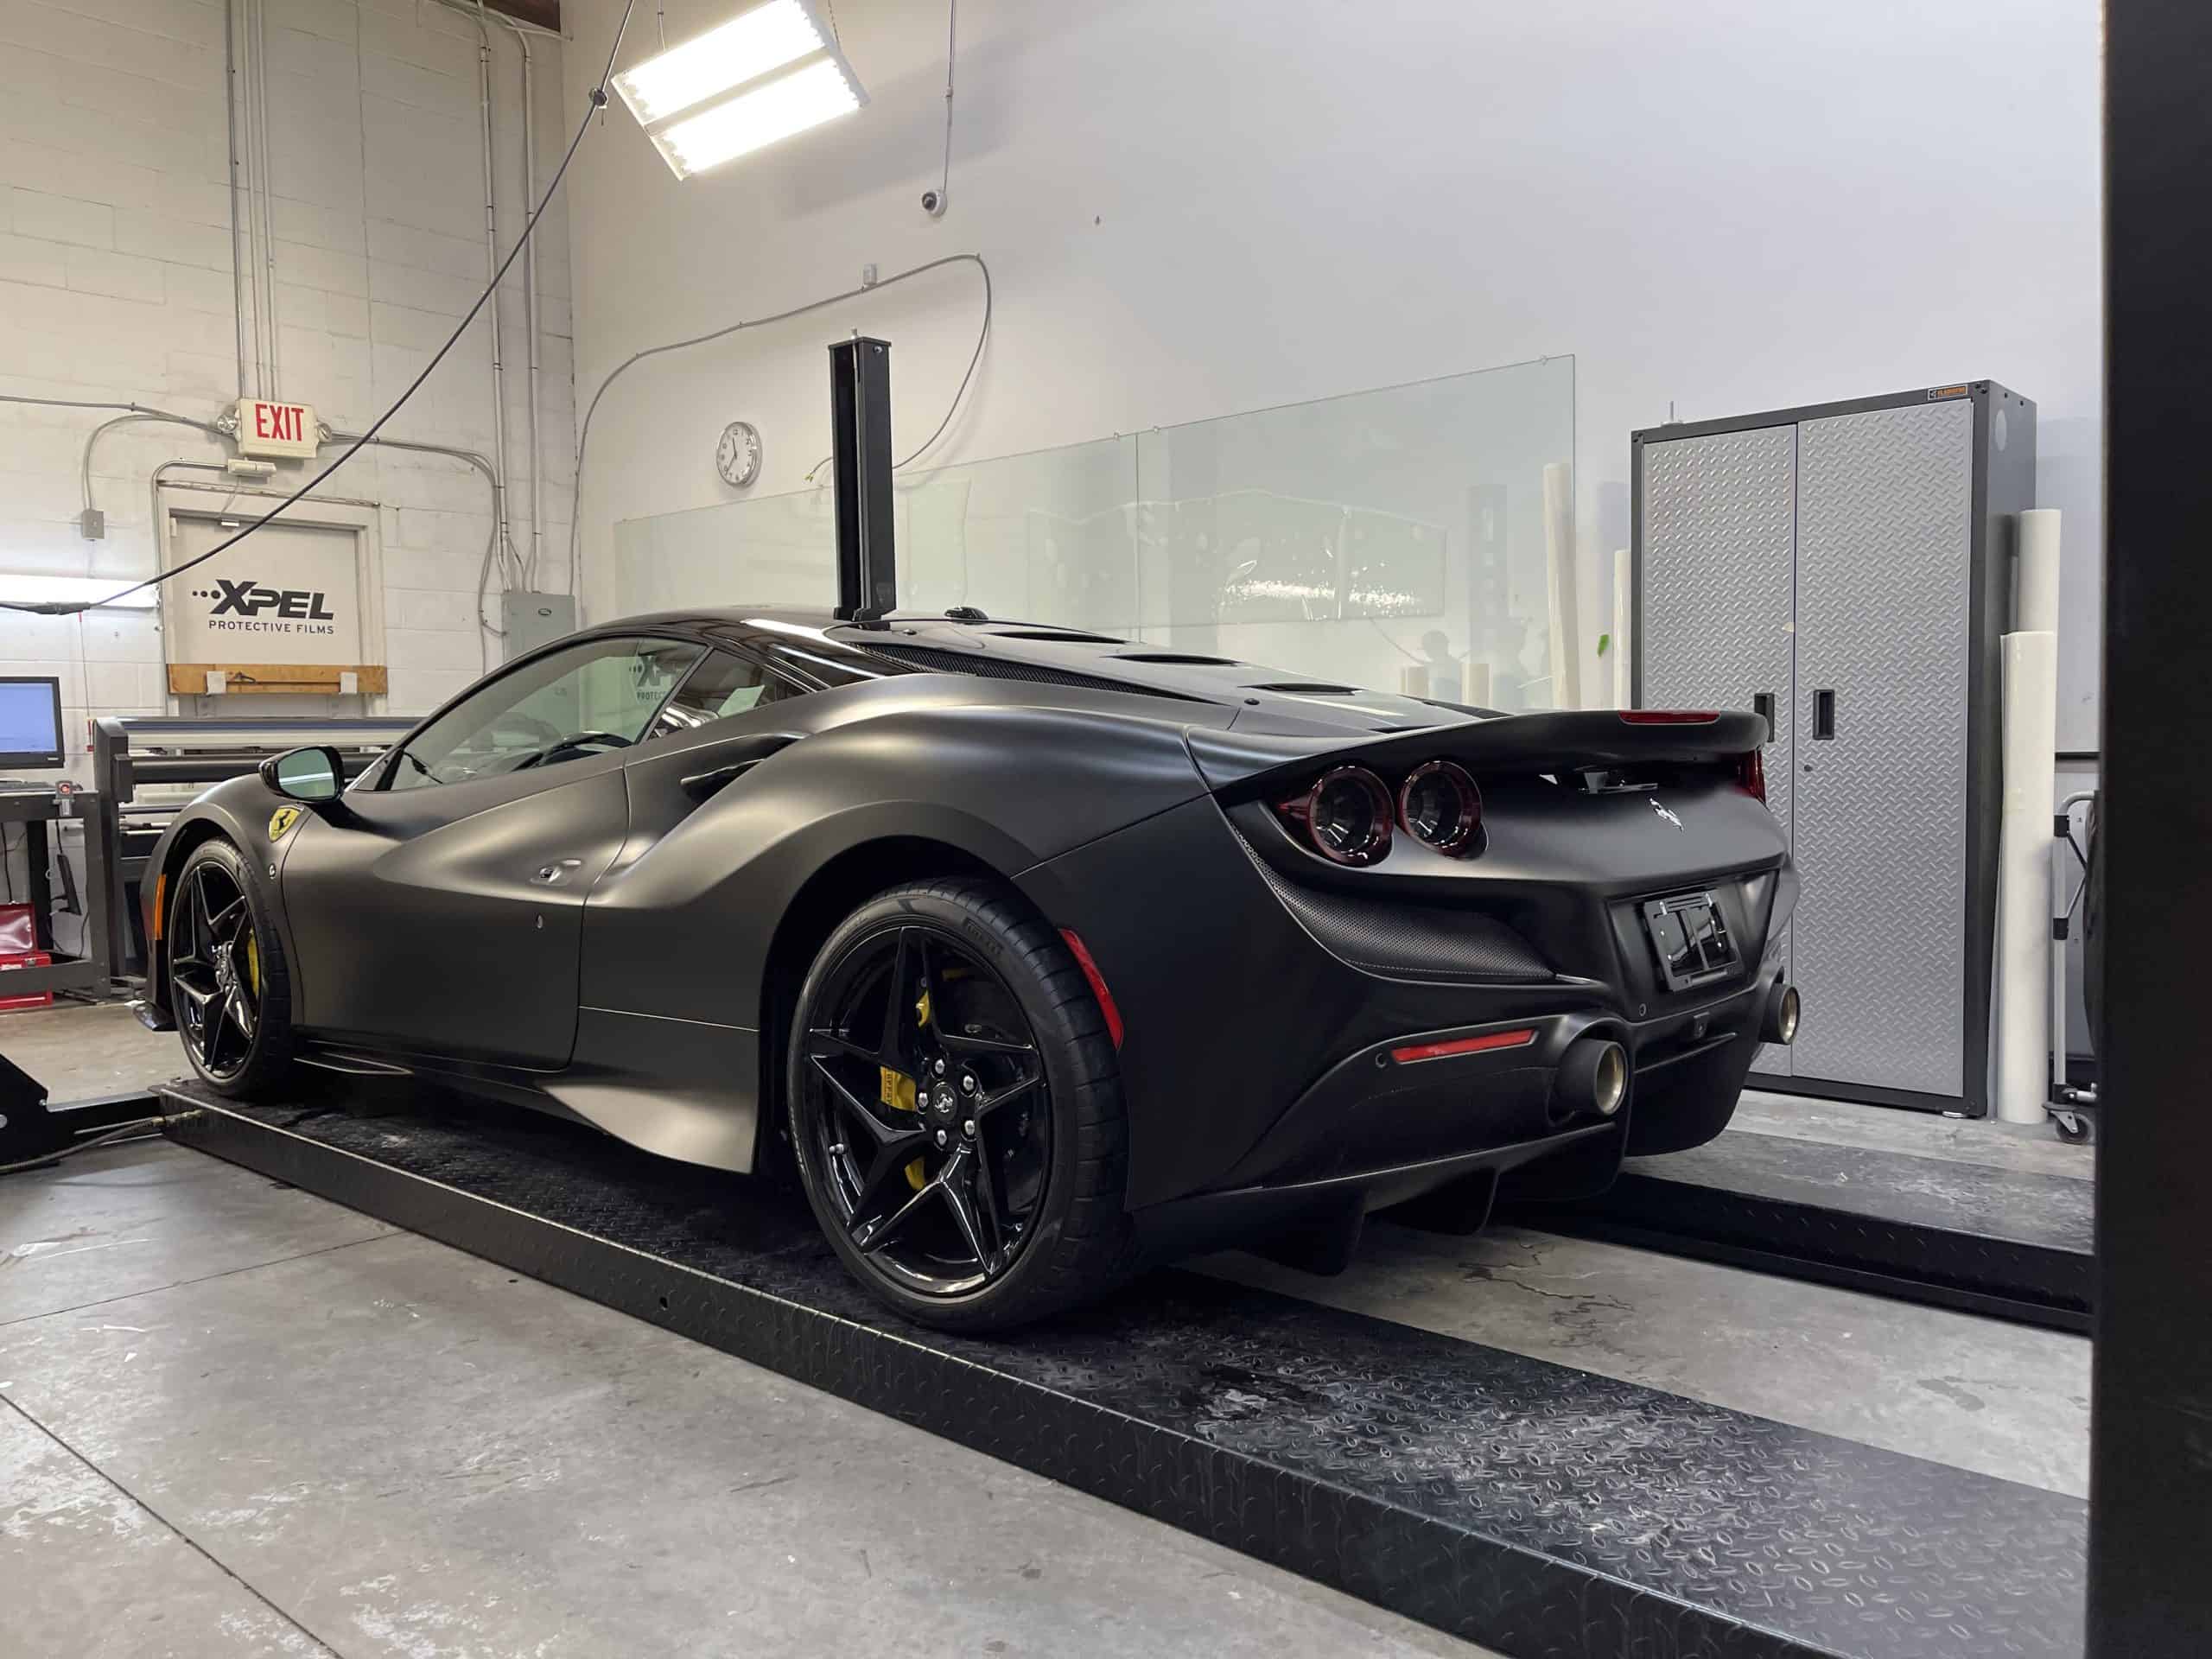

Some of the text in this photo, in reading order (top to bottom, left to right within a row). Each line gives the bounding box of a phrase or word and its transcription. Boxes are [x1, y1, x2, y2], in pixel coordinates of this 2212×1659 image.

[255, 404, 304, 442] EXIT
[209, 579, 334, 620] XPEL
[208, 620, 334, 634] PROTECTIVE FILMS
